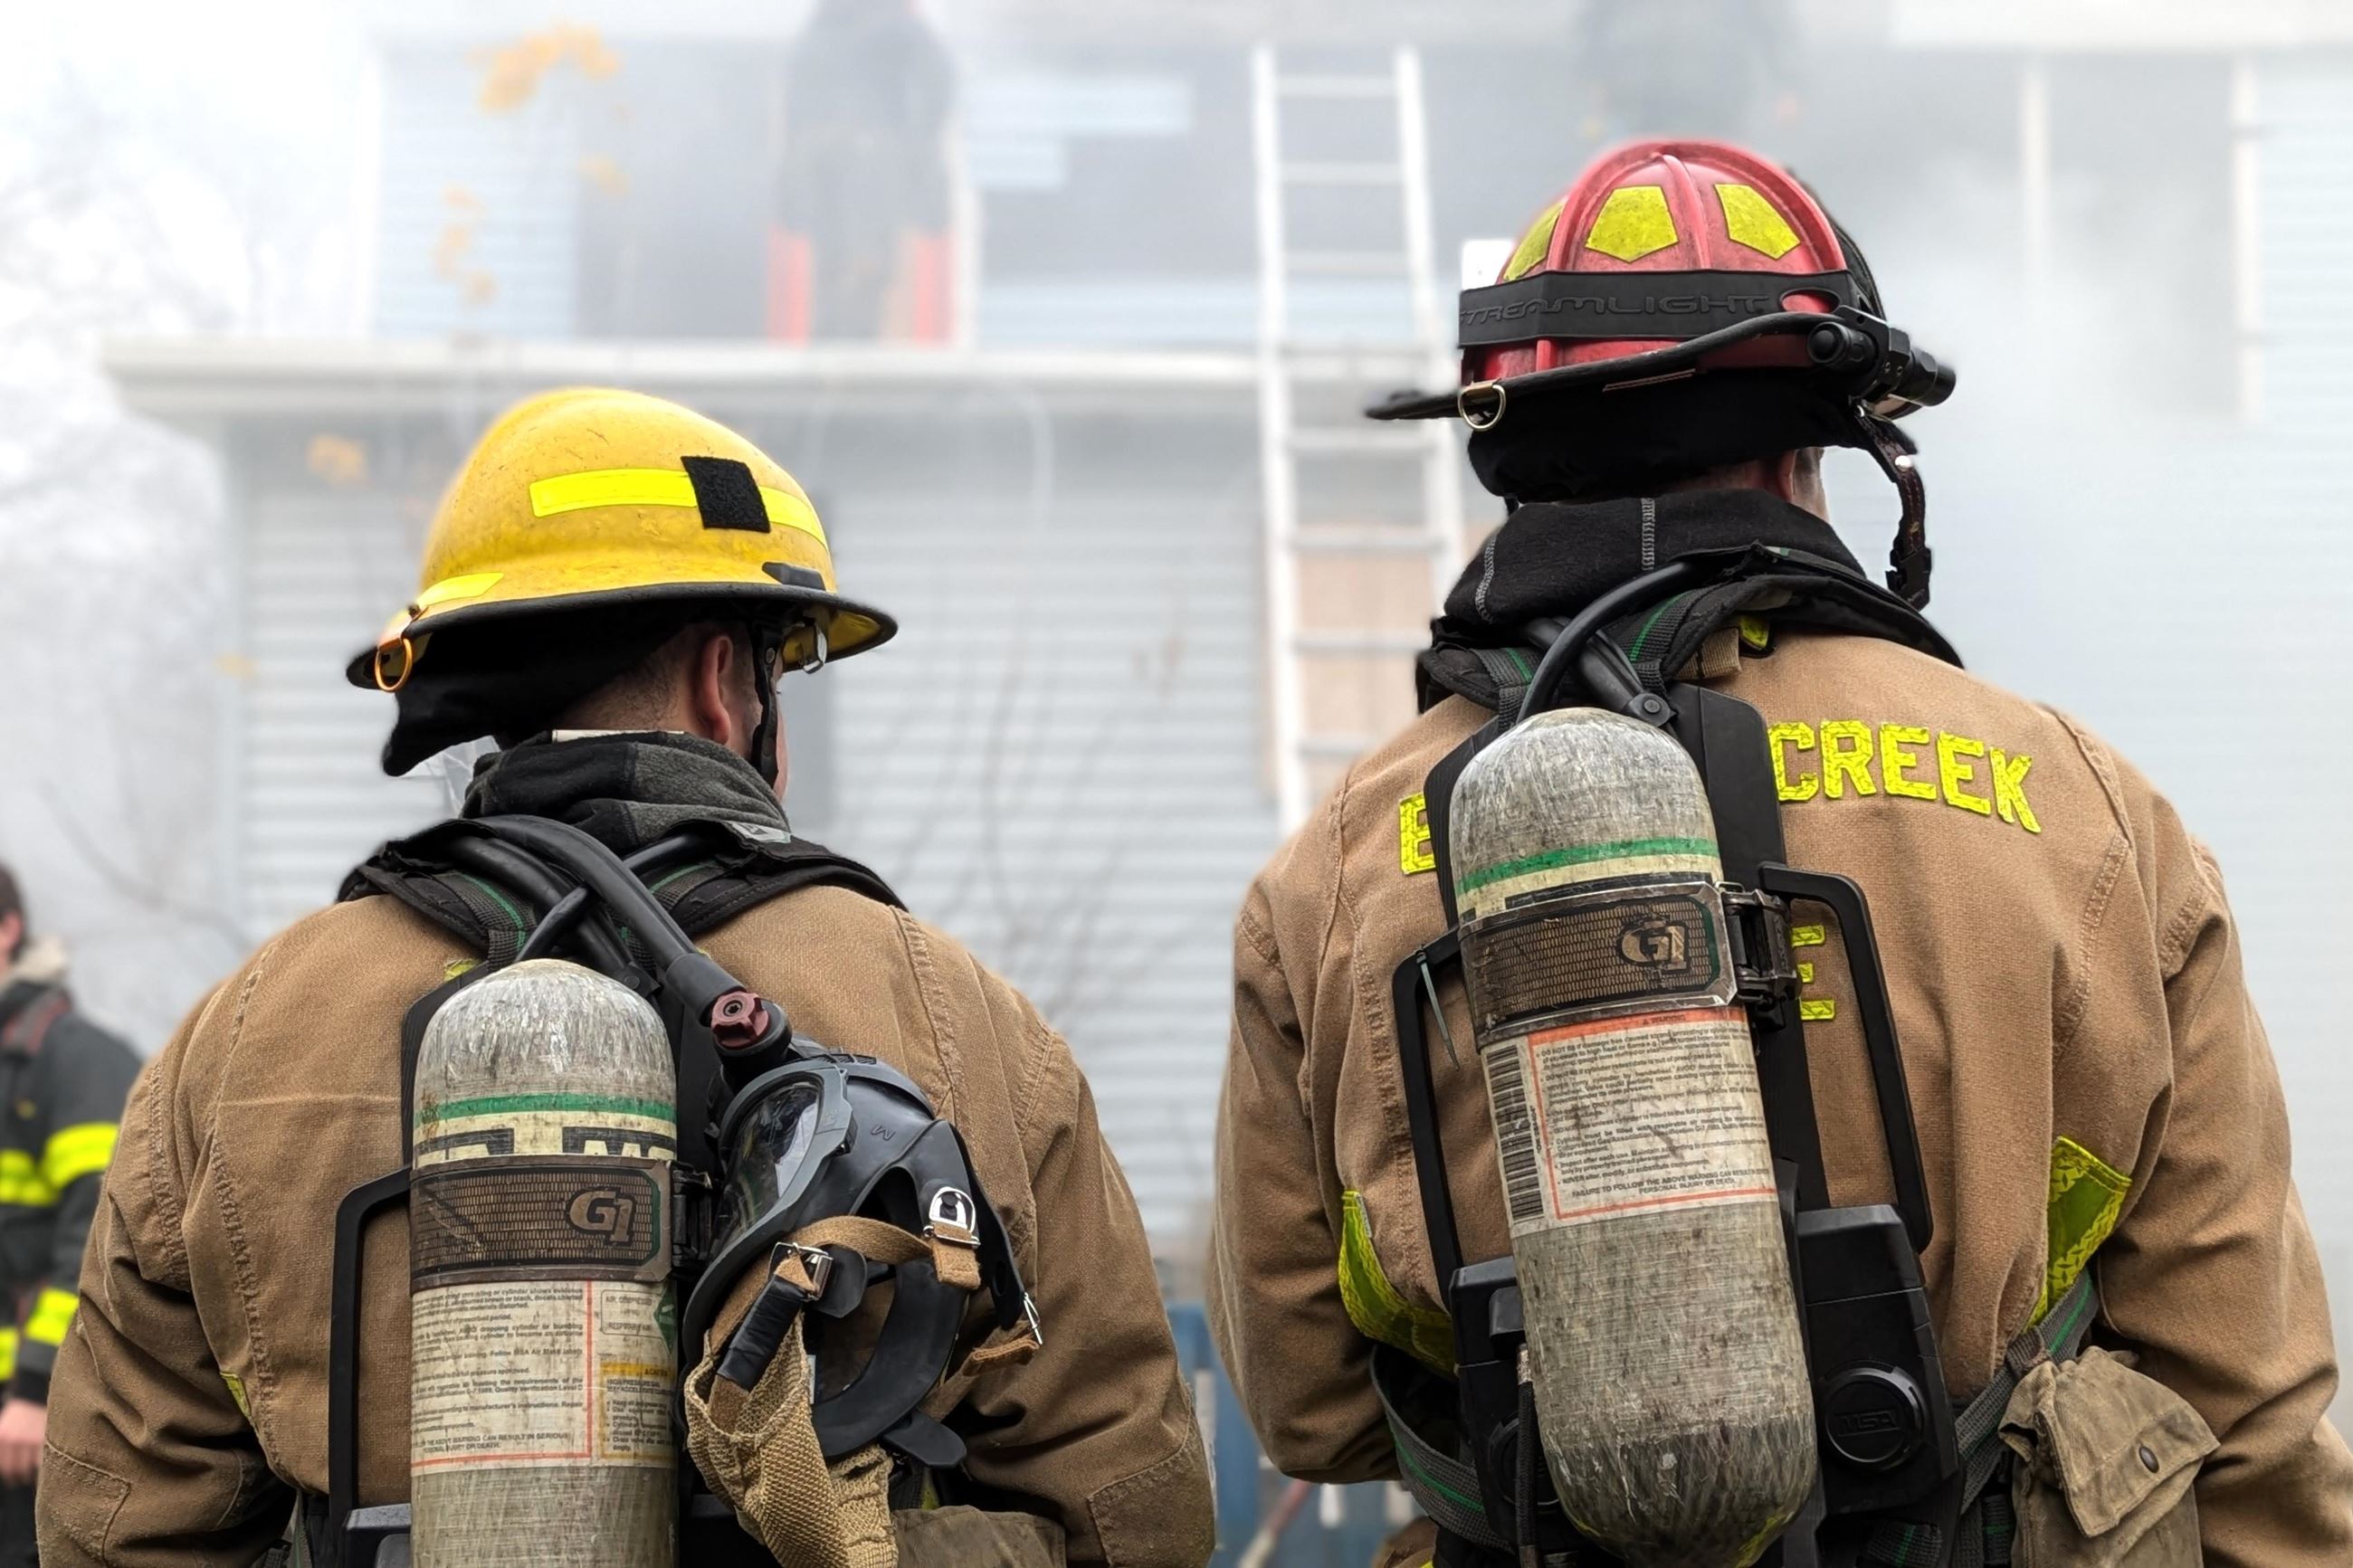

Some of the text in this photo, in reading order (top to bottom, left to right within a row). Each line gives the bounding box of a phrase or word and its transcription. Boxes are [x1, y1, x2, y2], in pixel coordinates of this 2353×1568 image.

[1767, 718, 2042, 833] CREEK
[1620, 918, 1689, 973] G1
[1573, 1187, 1600, 1196] FAILURE
[1614, 1181, 1644, 1191] FOLLOW
[1662, 1174, 1687, 1183] ABOVE
[1689, 1172, 1720, 1181] WARNING
[1639, 1183, 1678, 1194] PERSONAL
[567, 1188, 635, 1245] G1
